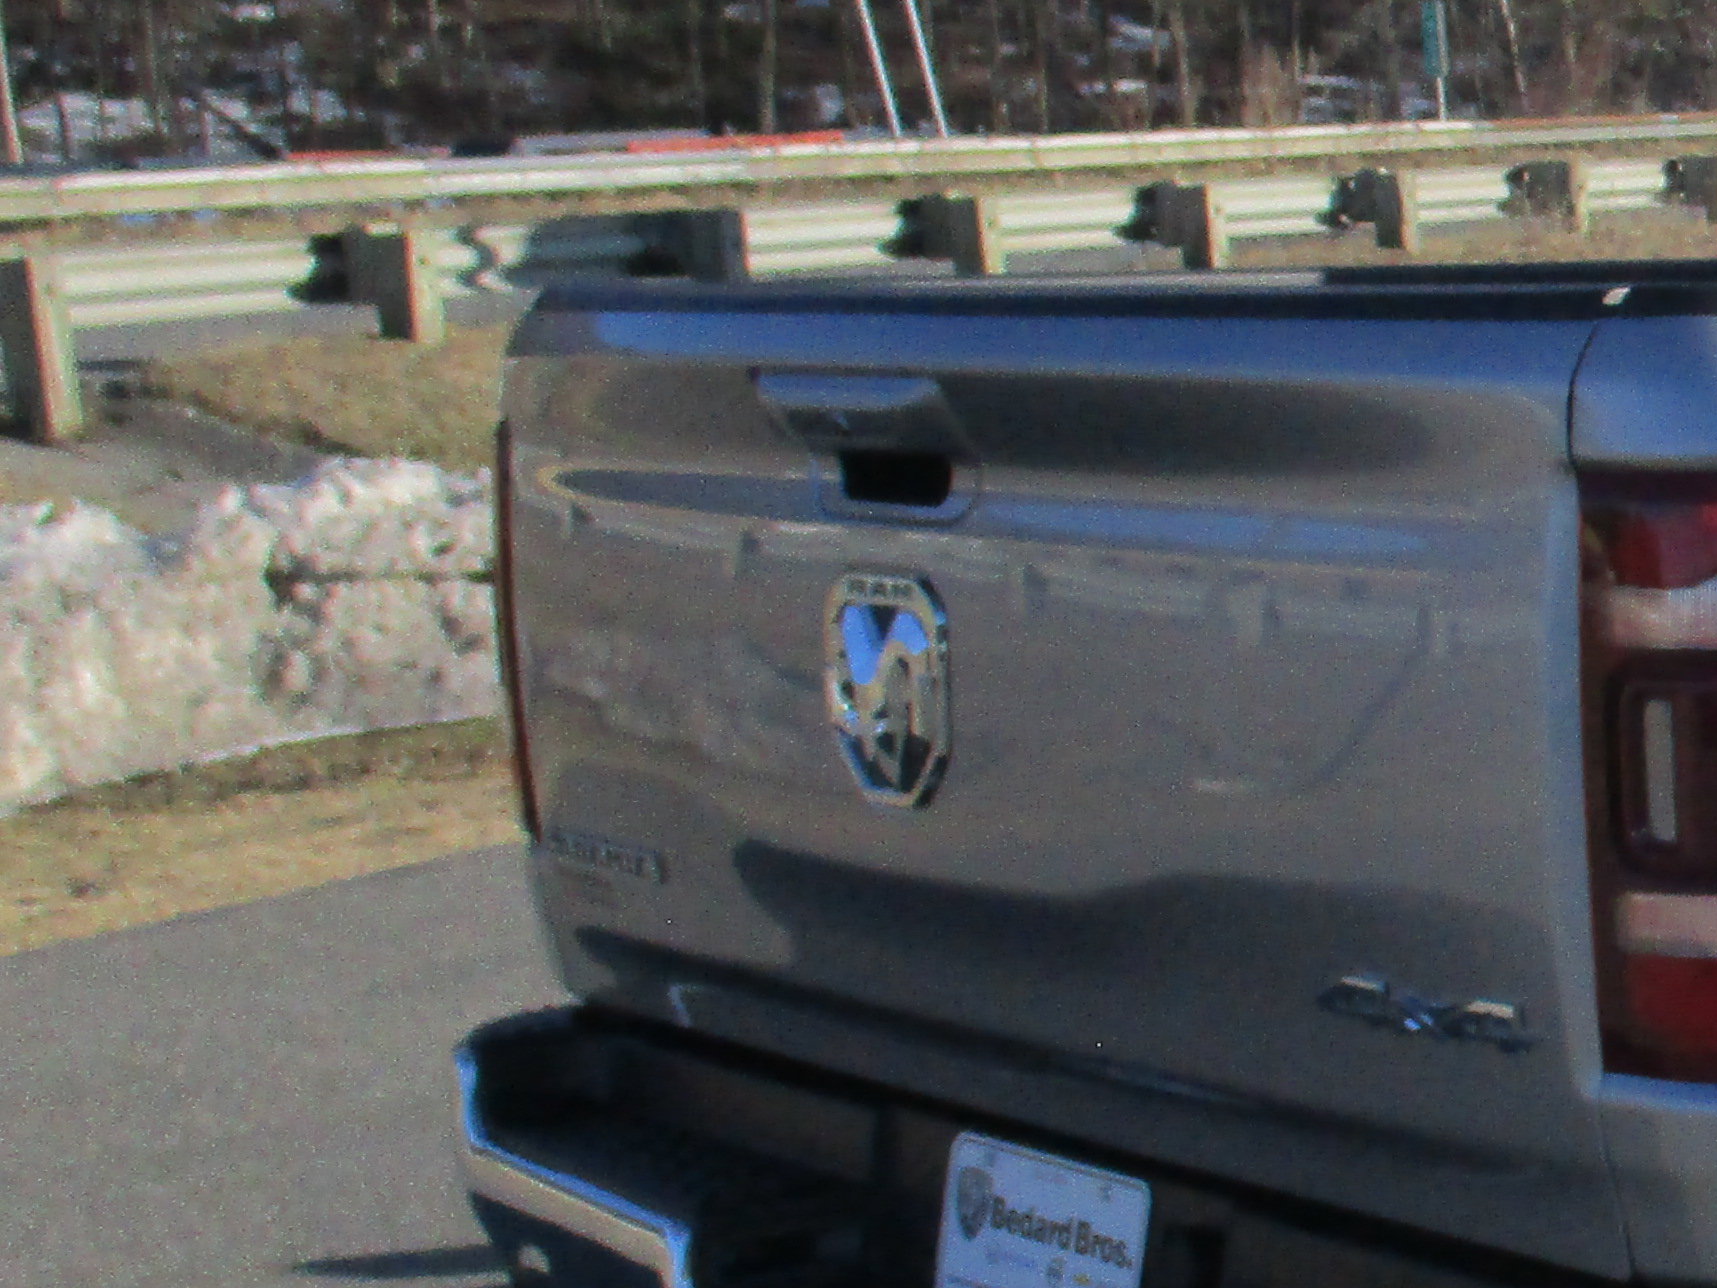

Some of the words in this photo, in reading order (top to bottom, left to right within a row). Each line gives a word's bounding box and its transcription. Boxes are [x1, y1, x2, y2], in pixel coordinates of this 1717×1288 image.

[846, 577, 915, 599] RAM
[990, 1195, 1072, 1251] Bedard
[1074, 1219, 1133, 1271] Bros.
